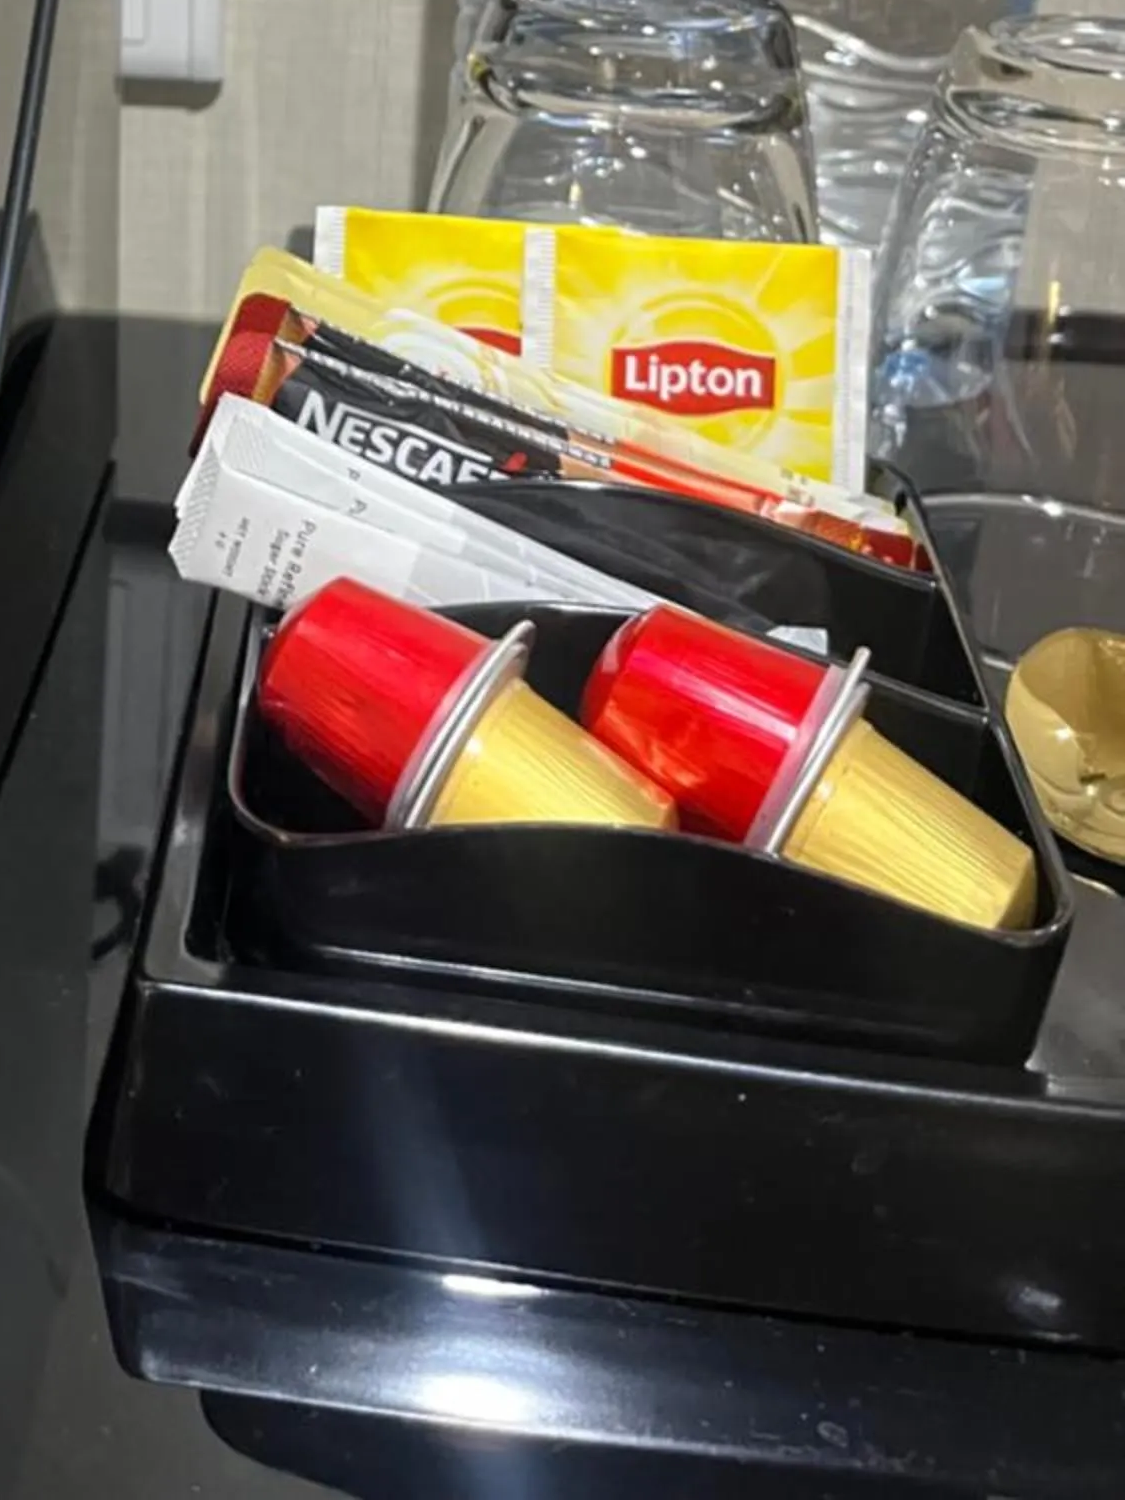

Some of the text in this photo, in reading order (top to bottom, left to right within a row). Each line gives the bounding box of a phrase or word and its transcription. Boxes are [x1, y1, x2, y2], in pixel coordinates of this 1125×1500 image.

[625, 353, 762, 402] Lipton
[295, 389, 520, 486] NESCAF
[290, 518, 318, 559] Pure
